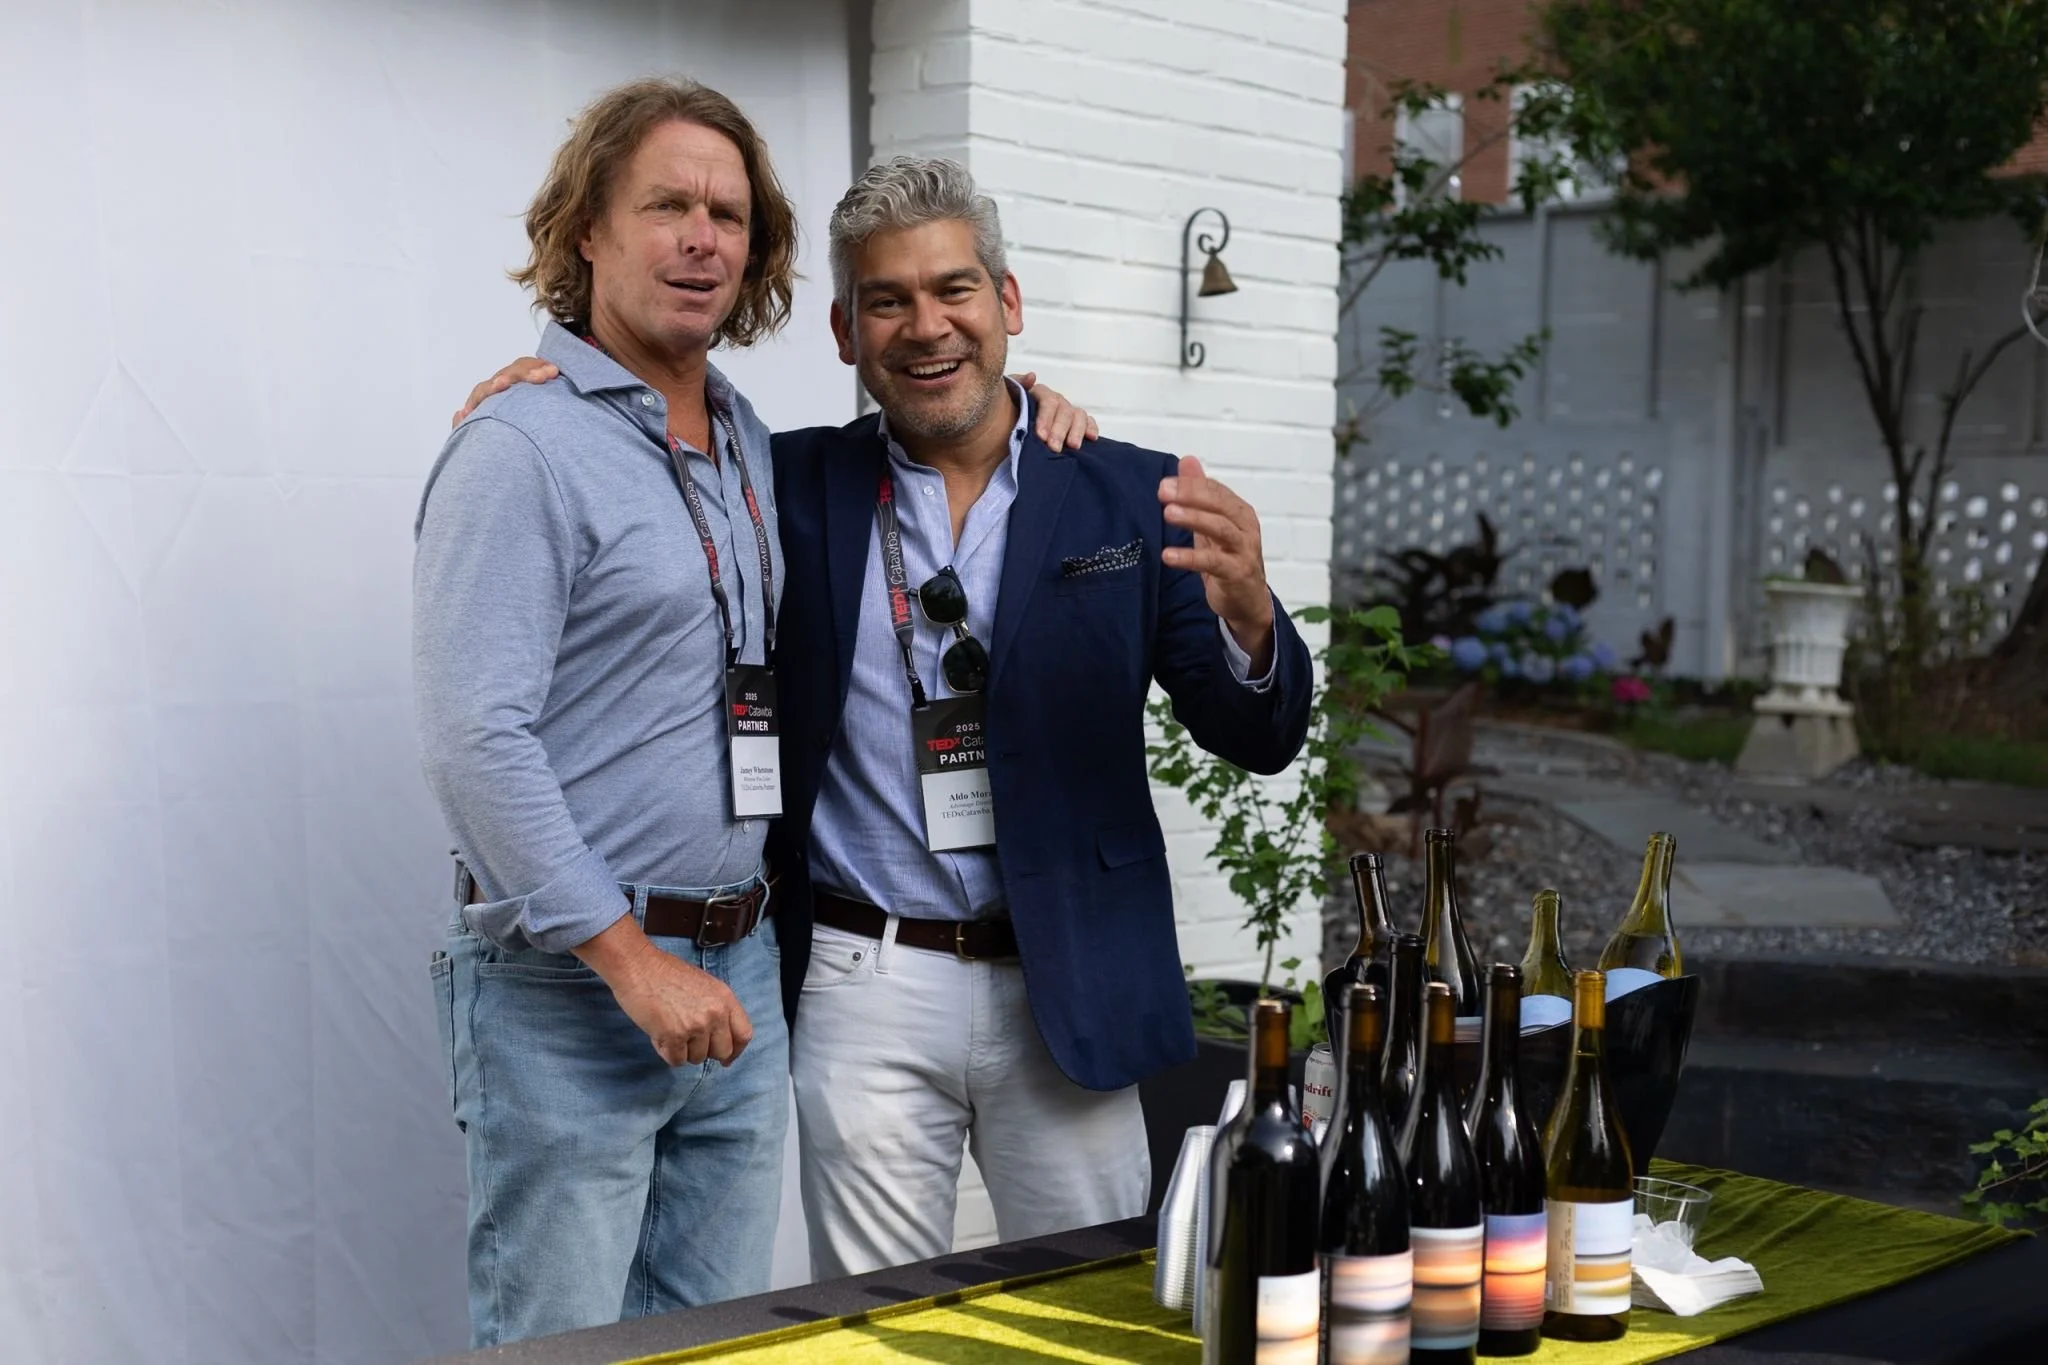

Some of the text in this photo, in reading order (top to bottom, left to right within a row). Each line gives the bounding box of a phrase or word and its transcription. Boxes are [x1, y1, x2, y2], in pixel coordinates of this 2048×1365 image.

[738, 720, 769, 732] PARTNER
[956, 722, 981, 733] 2025
[950, 793, 969, 802] Aldo
